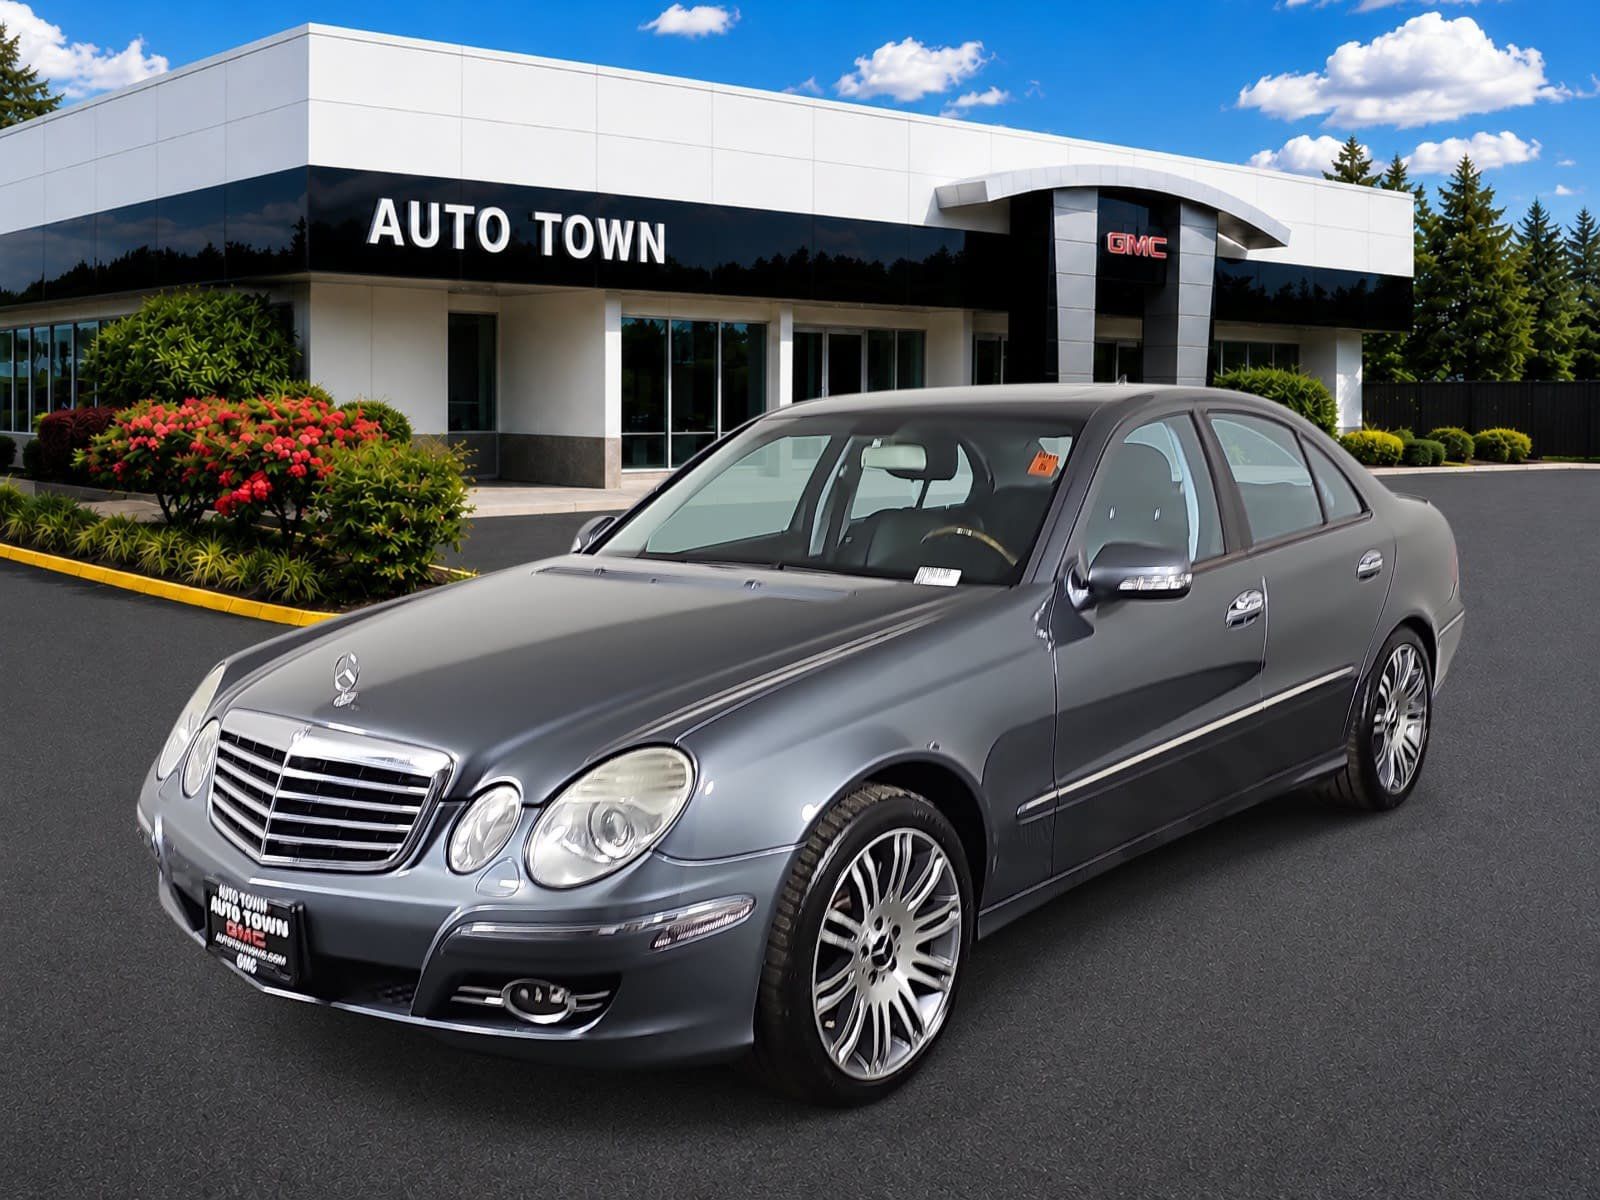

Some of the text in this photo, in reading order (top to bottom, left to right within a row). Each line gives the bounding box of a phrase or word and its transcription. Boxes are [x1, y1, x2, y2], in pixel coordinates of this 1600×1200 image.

[367, 197, 666, 264] AUTO TOWN
[1107, 231, 1167, 259] GMC
[210, 895, 289, 938] AUTO TOWN
[226, 920, 266, 948] GMC
